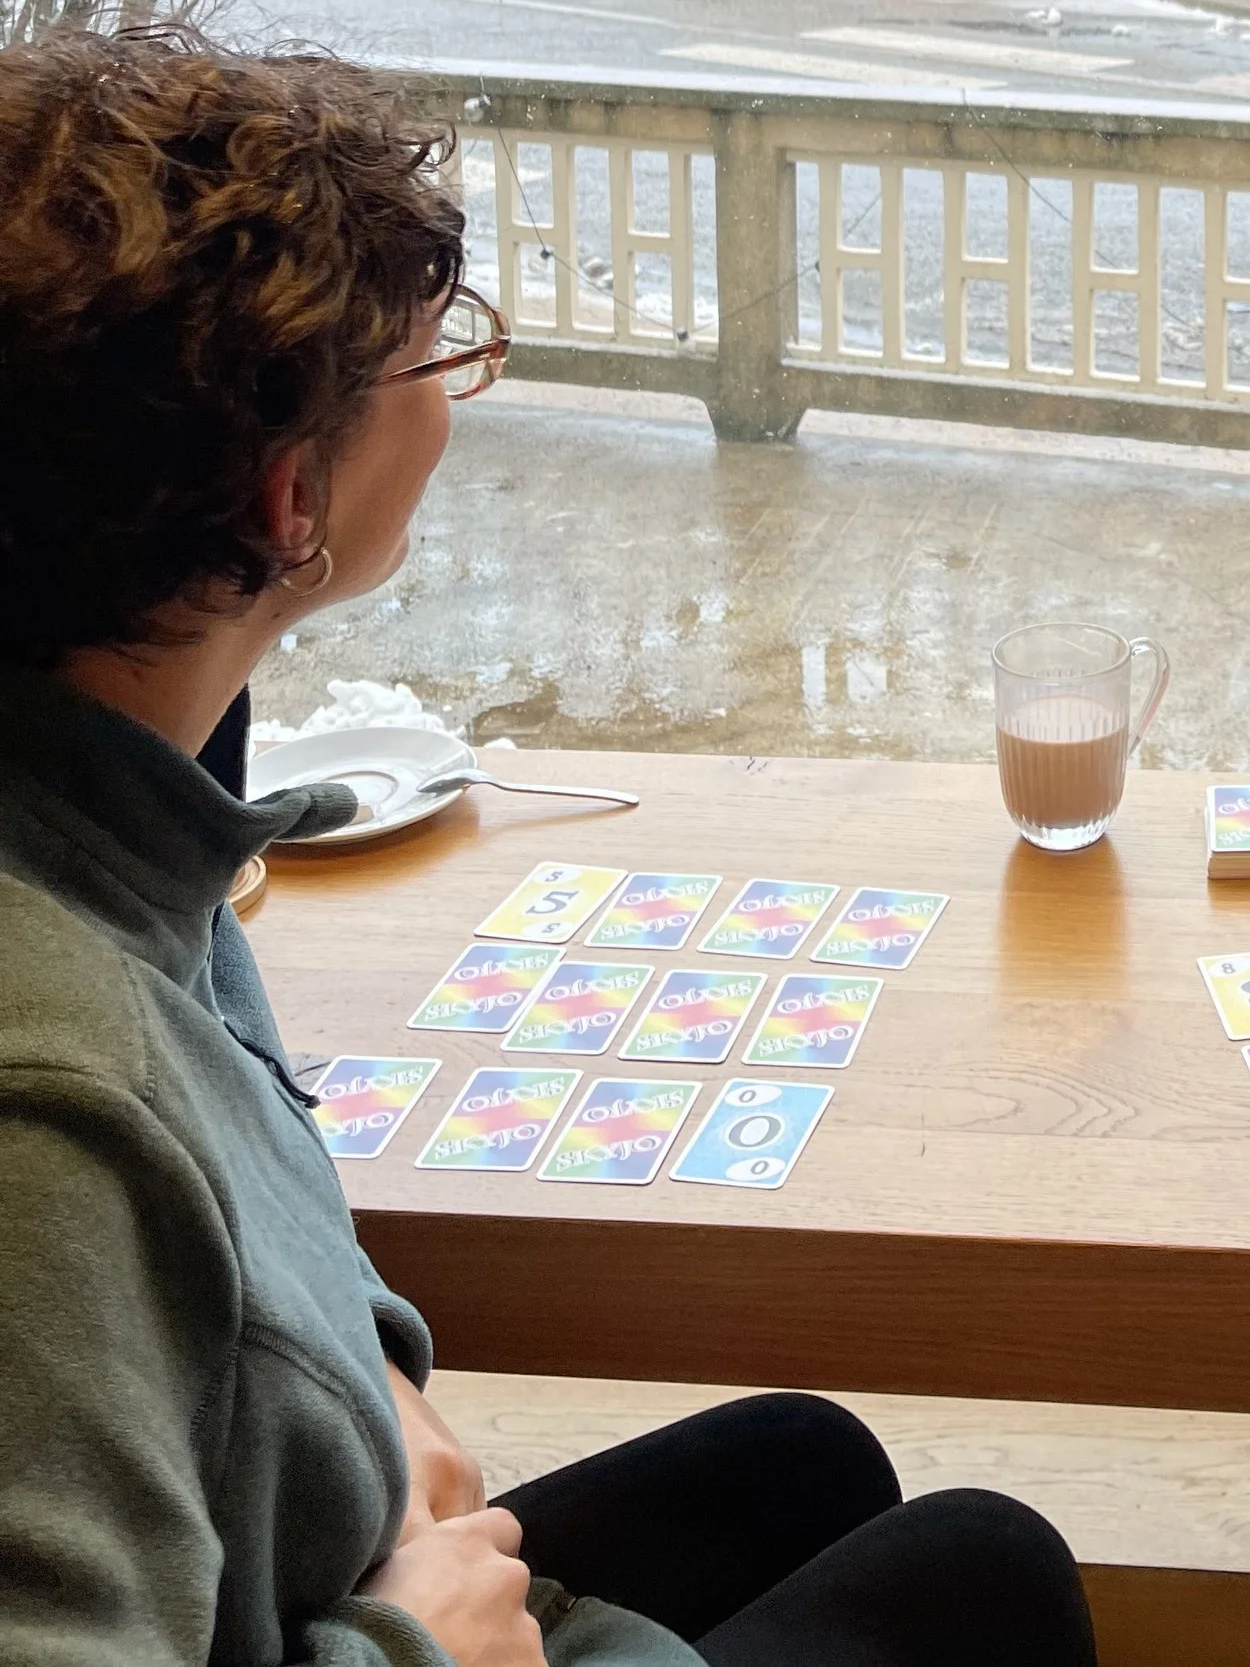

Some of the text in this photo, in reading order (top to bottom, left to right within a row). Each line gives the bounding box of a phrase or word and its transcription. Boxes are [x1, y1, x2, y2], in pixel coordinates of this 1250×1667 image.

[545, 870, 565, 882] 5
[526, 891, 579, 915] 5
[624, 881, 709, 905] SKYJO
[741, 890, 825, 912] SKYJO
[850, 900, 935, 922] SKYJO
[542, 922, 561, 935] 5
[602, 915, 690, 940] SKYJO
[716, 924, 804, 947] SKYJO
[828, 935, 915, 957] SKYJO
[456, 954, 549, 981] SKYJO
[1221, 963, 1236, 975] 8
[547, 972, 640, 1000] SKYJO
[660, 980, 752, 1009] SKYJO
[427, 993, 523, 1022] SKYJO
[779, 986, 869, 1015] SKYJO
[521, 1013, 617, 1043] SKYJO
[638, 1021, 733, 1051] SKYJO
[761, 1026, 854, 1058] SKYJO
[321, 1067, 424, 1100] SKYJO
[464, 1077, 565, 1112] SKYJO
[739, 1089, 757, 1103] 0
[584, 1090, 684, 1123] SKYJO
[437, 1124, 542, 1160] SKYJO
[729, 1115, 781, 1148] 0
[557, 1136, 662, 1172] SKYJO
[751, 1161, 770, 1175] 0
